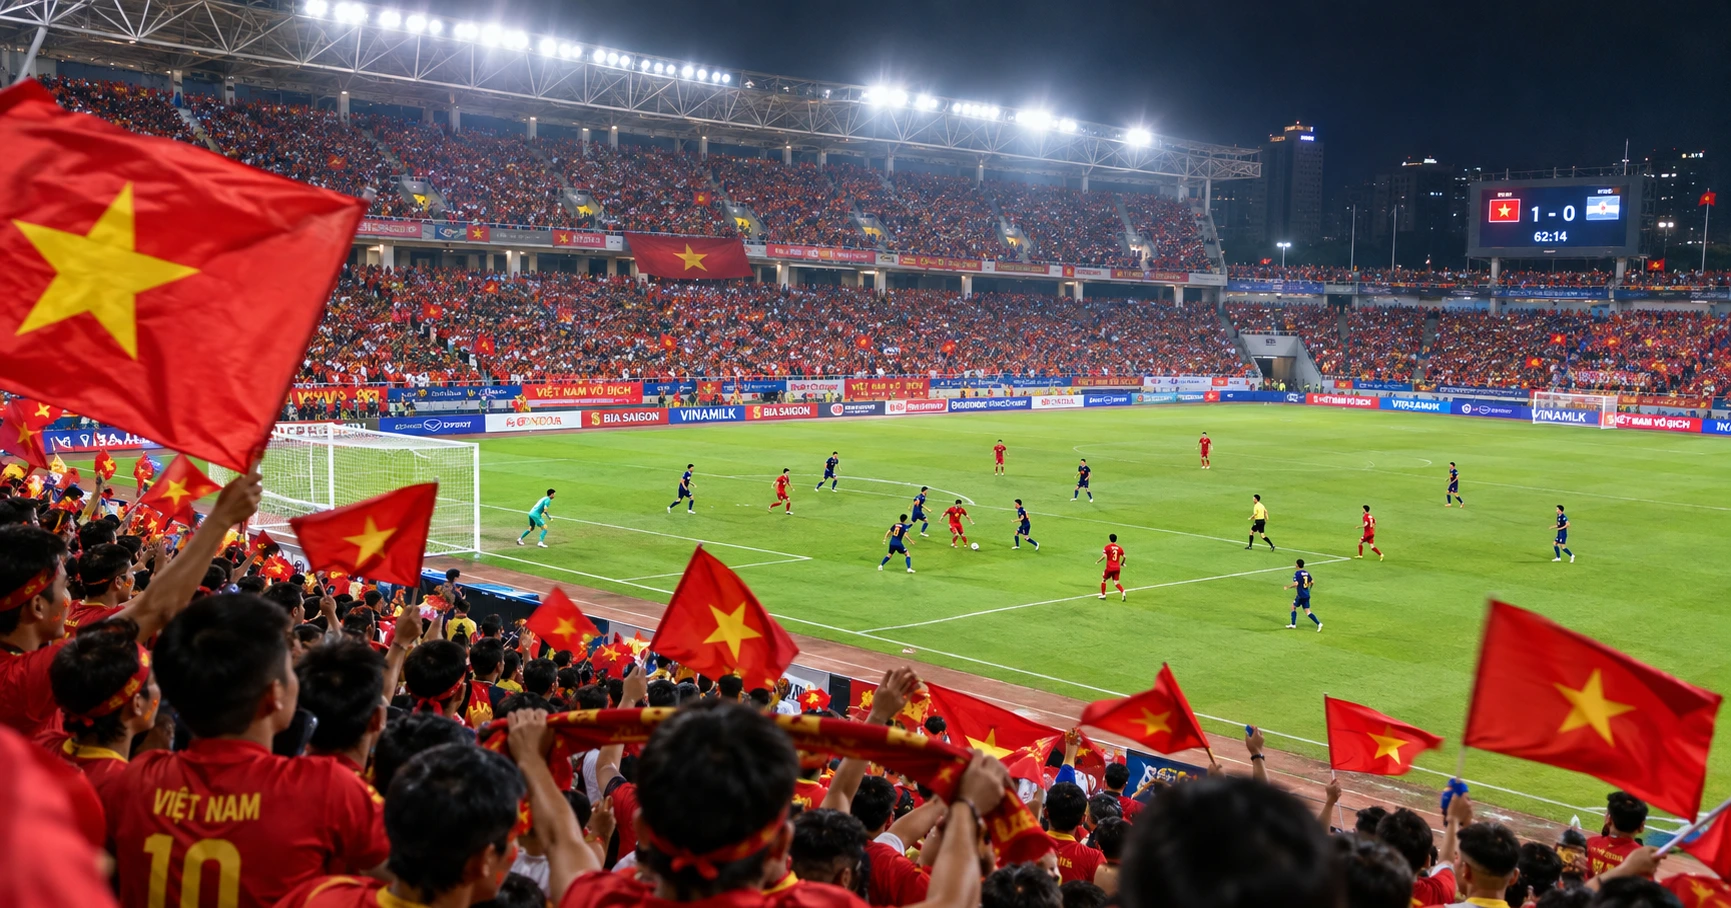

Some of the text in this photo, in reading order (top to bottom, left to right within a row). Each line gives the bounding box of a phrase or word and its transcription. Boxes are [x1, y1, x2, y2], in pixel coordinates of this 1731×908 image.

[1531, 206, 1539, 222] 1
[1563, 205, 1576, 222] 0
[1534, 231, 1568, 242] 62:14
[563, 386, 587, 396] NAM
[603, 413, 621, 423] BIA
[622, 412, 660, 422] SAIGON
[680, 408, 736, 421] VINAMILK
[763, 407, 778, 417] BIA
[779, 406, 810, 416] SAIGON
[153, 786, 261, 824] VIỆT NAM
[143, 832, 241, 908] 10
